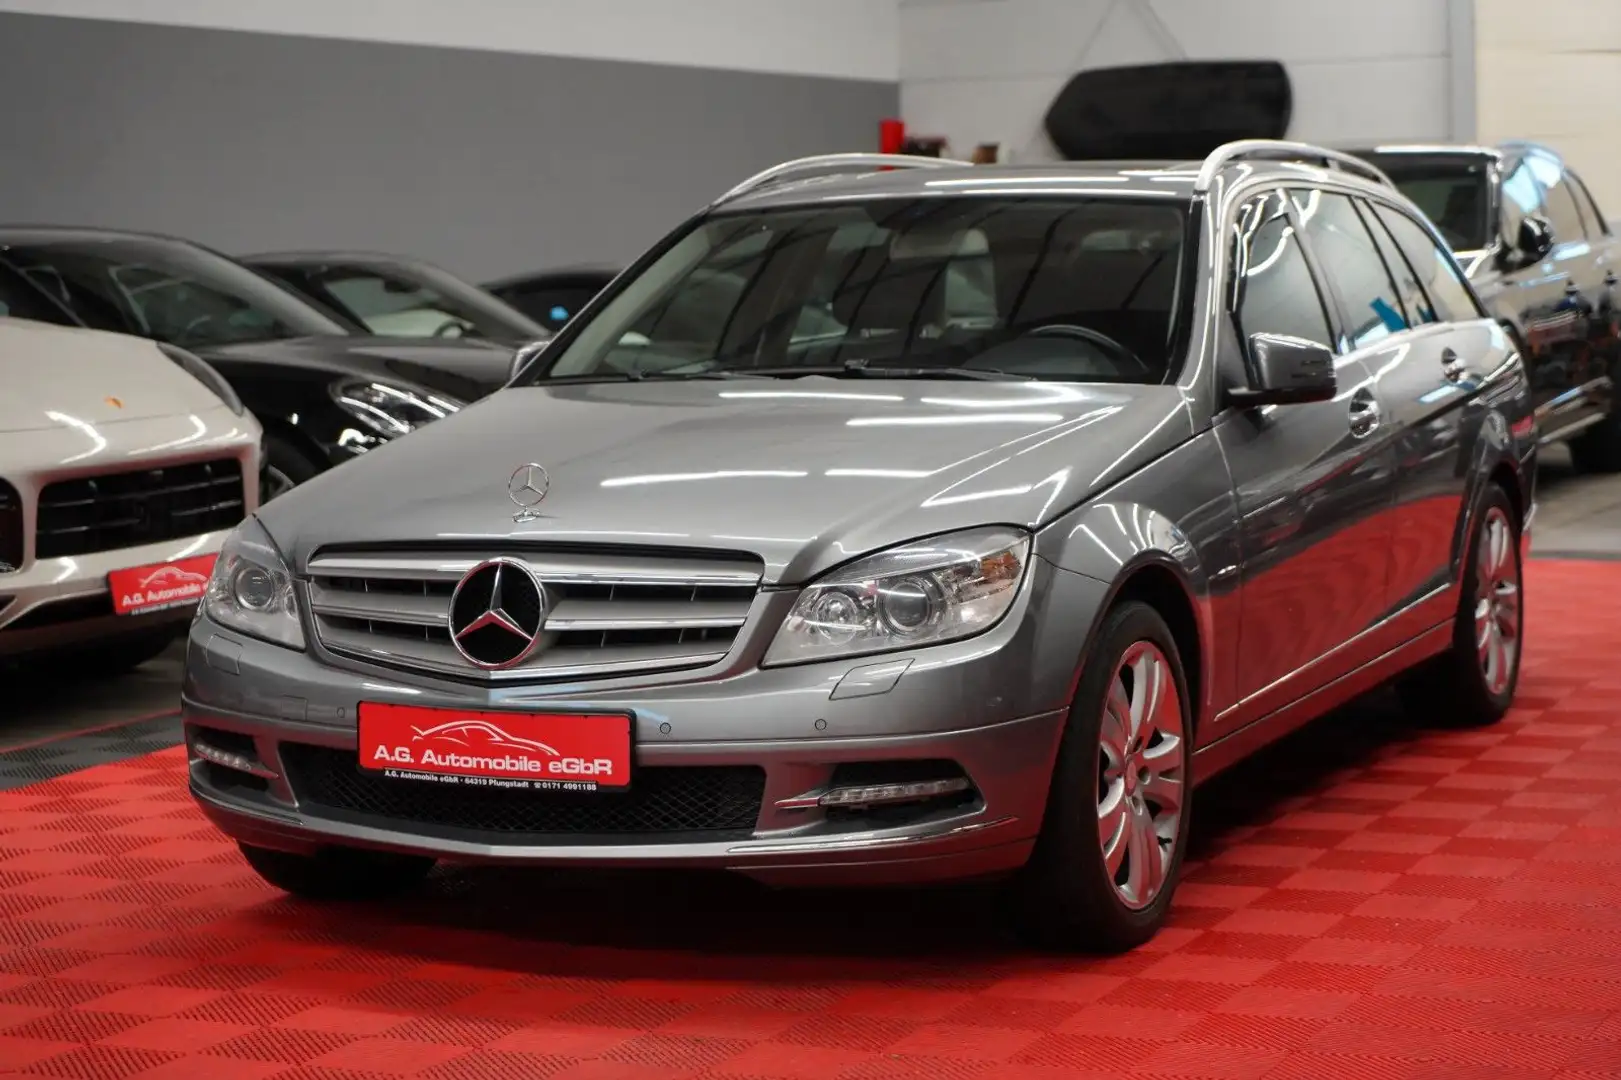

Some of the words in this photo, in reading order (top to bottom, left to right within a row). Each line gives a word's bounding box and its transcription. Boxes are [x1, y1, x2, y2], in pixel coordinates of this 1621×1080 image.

[122, 593, 145, 607] A.G.
[374, 745, 415, 763] A.G.
[421, 749, 542, 773] Automobile
[548, 757, 612, 775] eGbR
[384, 770, 399, 778] A.G.
[400, 771, 438, 782] Automobile
[440, 775, 459, 784] eGbR
[464, 778, 488, 786] 64319
[488, 779, 529, 788] Pfungstadt
[542, 782, 561, 790] 0171
[563, 783, 597, 791] 4991188
